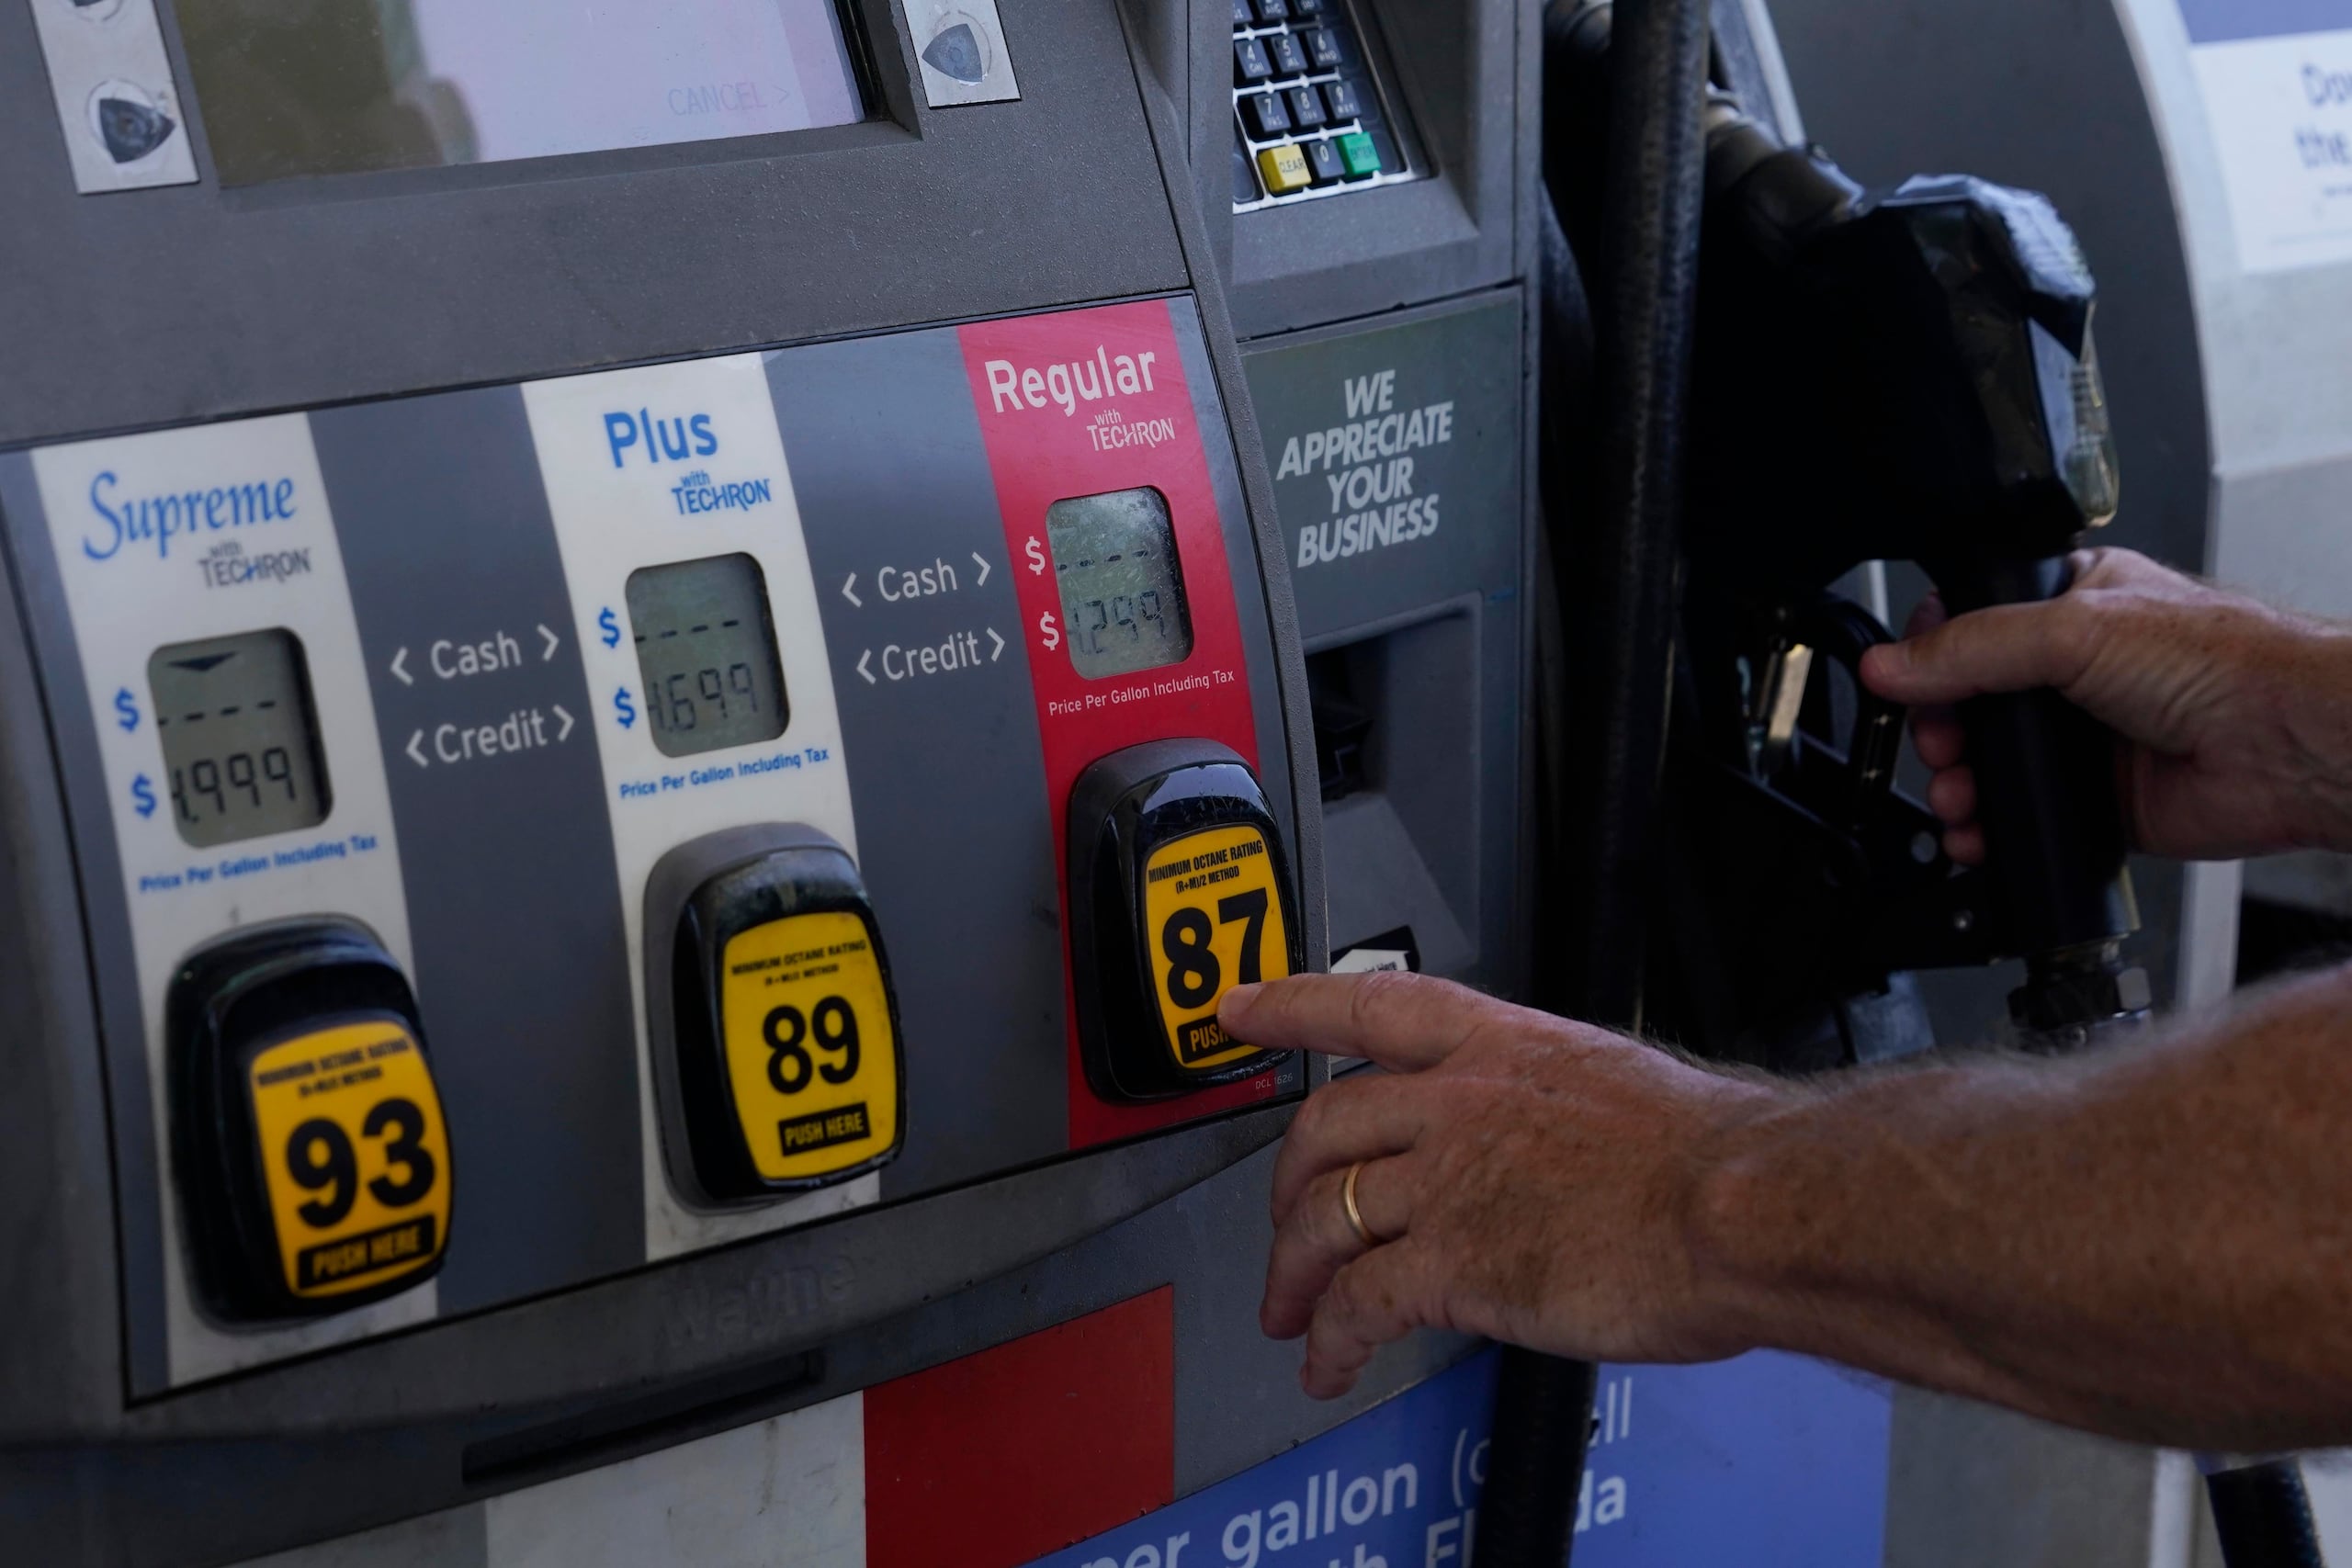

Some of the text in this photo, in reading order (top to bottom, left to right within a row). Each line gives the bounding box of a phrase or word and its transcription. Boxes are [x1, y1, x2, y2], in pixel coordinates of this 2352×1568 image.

[1282, 39, 1292, 57] 5
[1317, 32, 1327, 51] 6
[668, 81, 768, 116] CANCEL
[1263, 97, 1273, 115] 7
[1300, 91, 1311, 110] 8
[1318, 144, 1329, 163] 0
[985, 344, 1156, 417] Regular
[1344, 368, 1396, 419] WE
[603, 406, 718, 468] Plus
[1086, 417, 1176, 452] TECHRON
[1094, 408, 1122, 426] with
[1275, 400, 1454, 481] APPRECIATE
[671, 479, 772, 515] TECHRON
[680, 470, 711, 489] with
[1327, 456, 1415, 514] YOUR
[83, 471, 296, 560] Supreme
[1296, 493, 1441, 569] BUSINESS
[198, 548, 312, 590] TECHRON
[1024, 536, 1046, 576] $
[877, 558, 958, 603] Cash
[598, 607, 620, 649] $
[1039, 611, 1061, 651] $
[430, 630, 522, 680] Cash
[882, 630, 981, 681] Credit
[114, 688, 141, 732] $
[614, 686, 636, 729] $
[1048, 668, 1235, 716] Price Per Gallon Including Tax
[434, 708, 548, 764] Credit
[132, 772, 157, 819] $
[620, 748, 830, 800] Price Per Gallon Including Tax
[187, 866, 213, 884] Per
[219, 856, 270, 879] Gallon
[275, 840, 346, 866] Including
[350, 834, 378, 853] Tax
[1148, 840, 1263, 884] MINIMUM OCTANE RATING
[1176, 865, 1240, 895] (R+M)/2 METHOD
[1162, 887, 1269, 1009] 87
[763, 995, 860, 1094] 89
[1255, 1072, 1294, 1090] DCL 1626
[784, 1110, 865, 1147] PUSH HERE
[287, 1098, 435, 1228] 93
[311, 1223, 422, 1280] PUSH HERE
[1221, 1461, 1419, 1567] gallon
